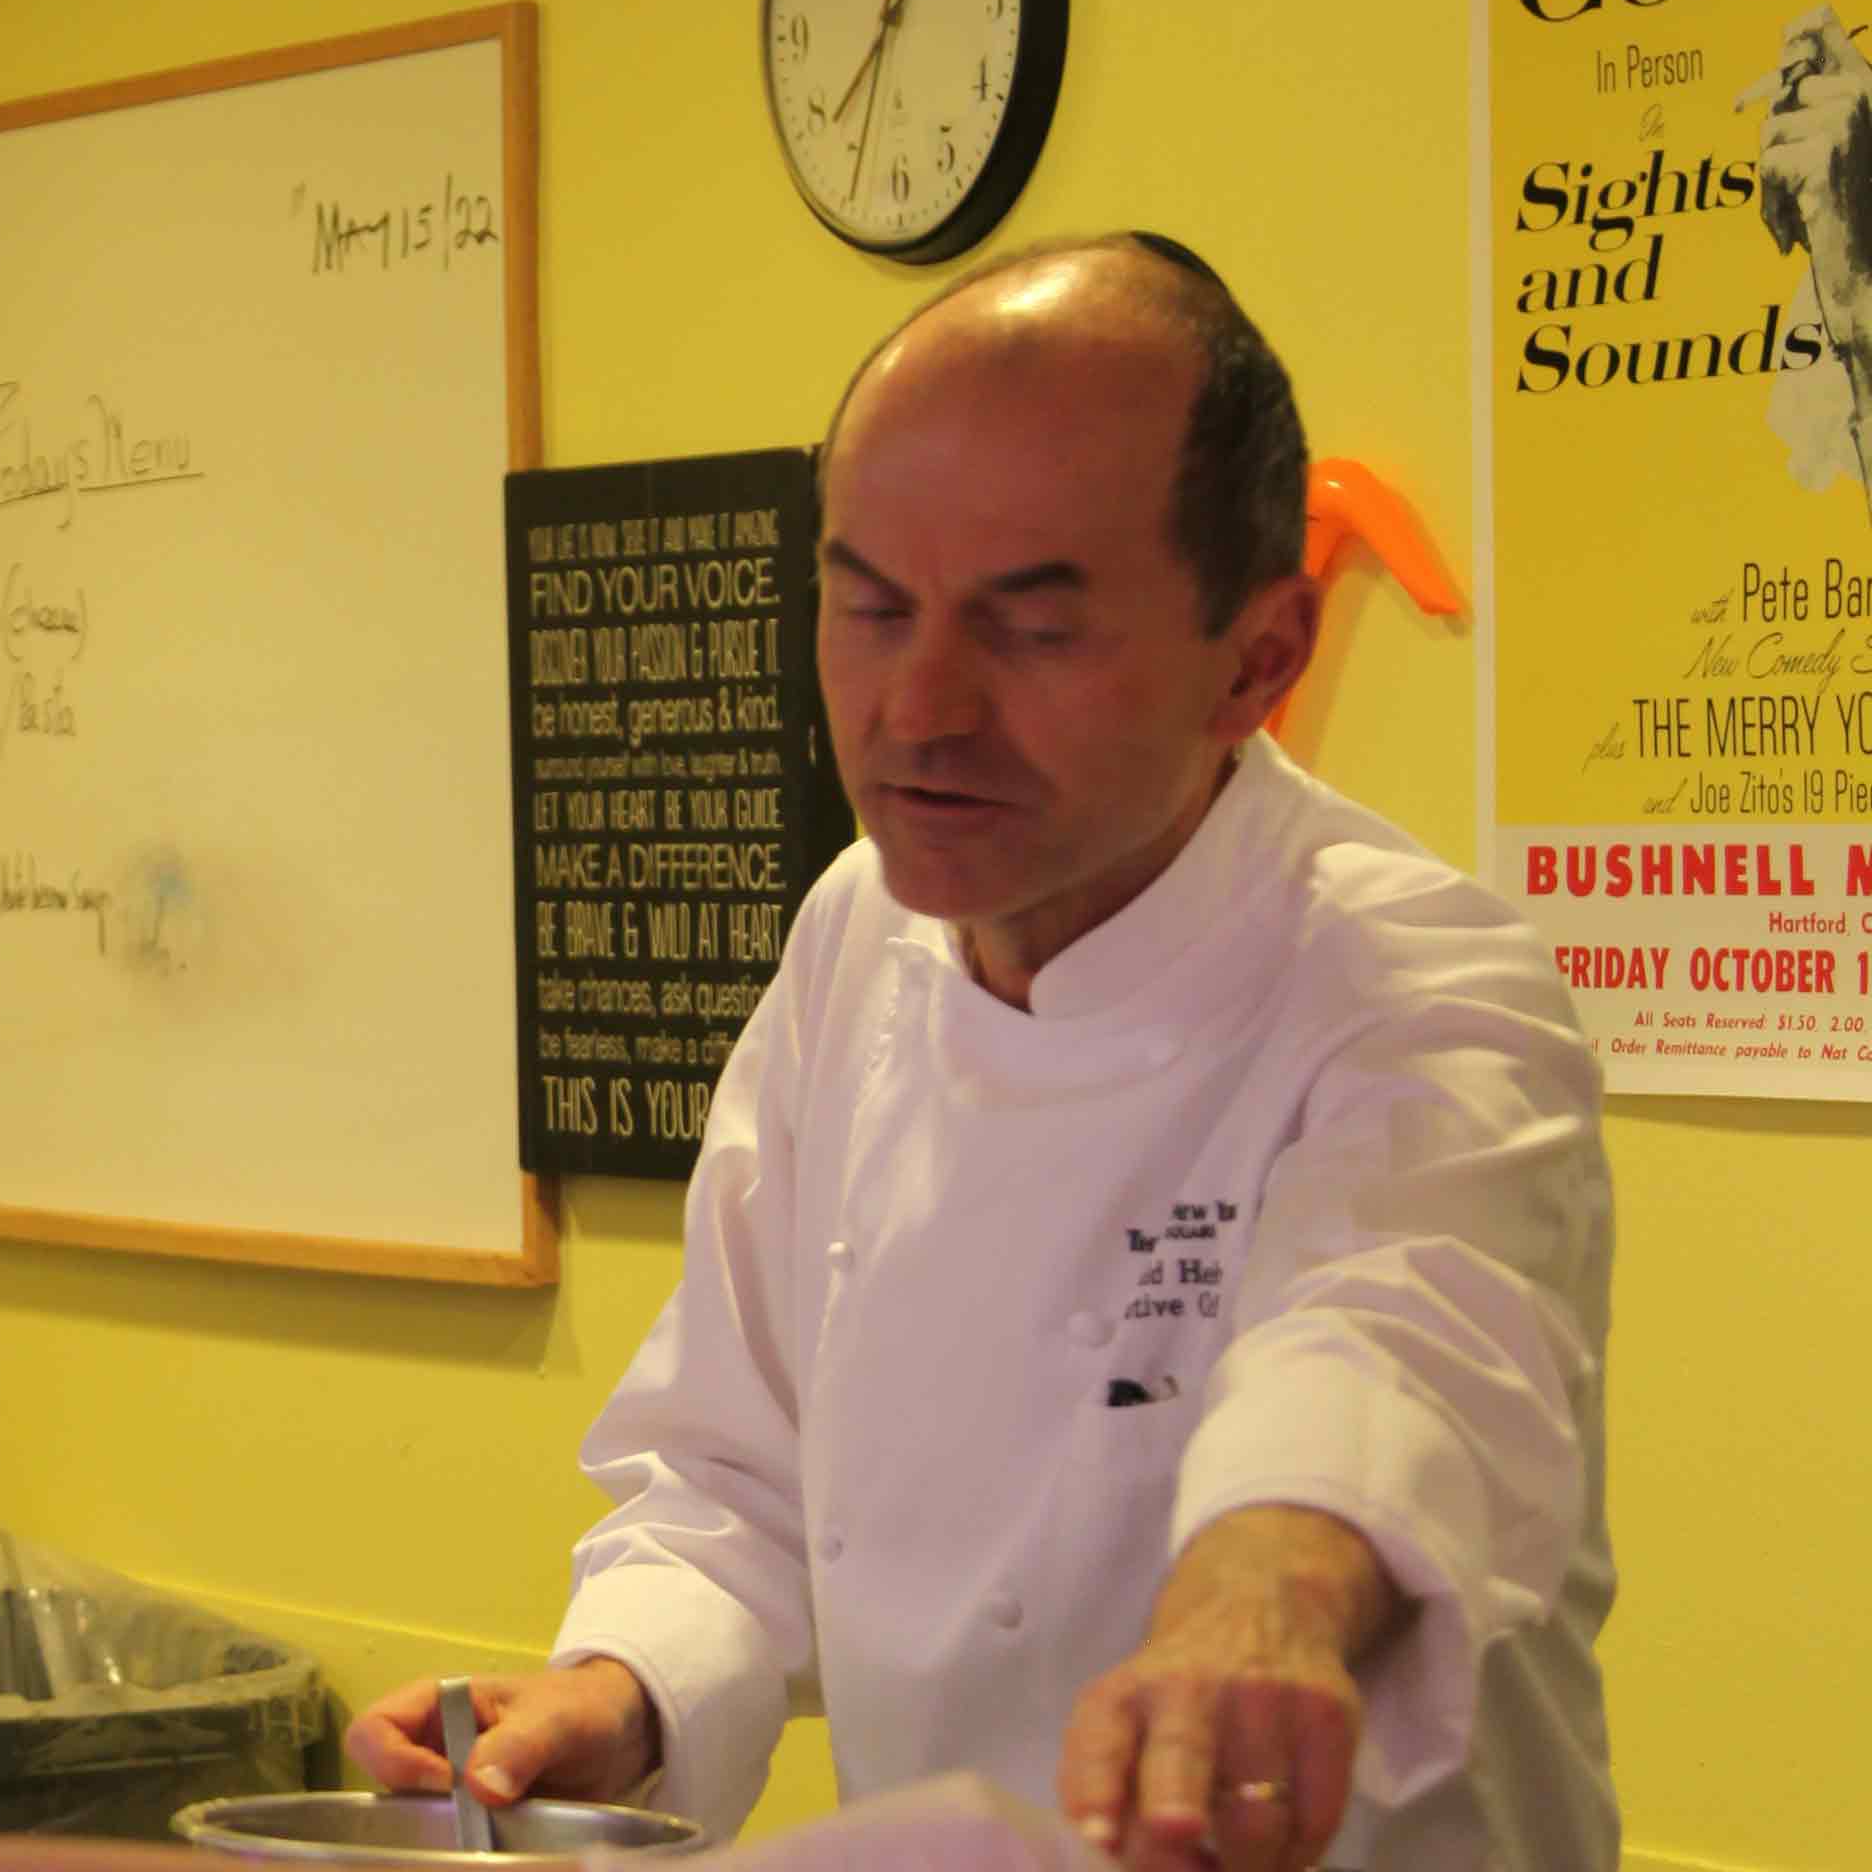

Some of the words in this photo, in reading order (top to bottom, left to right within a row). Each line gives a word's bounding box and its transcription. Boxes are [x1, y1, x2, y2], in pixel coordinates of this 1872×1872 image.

[791, 14, 810, 64] 9
[971, 56, 990, 102] 4
[1596, 50, 1616, 94] In
[1627, 45, 1703, 89] Person
[936, 123, 956, 172] 5
[891, 152, 910, 204] 6
[1516, 149, 1757, 253] Sights
[1517, 233, 1664, 314] and
[1516, 304, 1823, 394] Sounds
[530, 569, 592, 617] FIND
[597, 564, 679, 616] YOUR
[684, 557, 781, 610] VOICE.
[1743, 562, 1809, 623] Pete
[1681, 632, 1741, 680] New
[1745, 628, 1846, 696] Comedy
[532, 693, 556, 737] be
[559, 692, 624, 740] honest,
[629, 697, 714, 747] generous
[735, 684, 783, 732] kind.
[1632, 698, 1692, 758] THE
[1706, 694, 1820, 758] MERRY
[535, 791, 561, 831] LET
[566, 790, 604, 831] YOUR
[608, 789, 657, 830] HEART
[664, 789, 683, 830] BE
[688, 788, 728, 830] YOUR
[1689, 771, 1730, 815] Joe
[1739, 768, 1794, 815] Zito's
[1803, 768, 1824, 815] 19
[535, 842, 602, 889] MAKE
[607, 843, 625, 889] A
[629, 842, 786, 891] DIFFERENCE.
[1527, 843, 1815, 897] BUSHNELL
[536, 901, 558, 959] BE
[564, 900, 616, 960] BRAVE
[647, 901, 692, 961] WILD
[698, 902, 721, 960] AT
[1768, 911, 1850, 936] Hartford,
[537, 968, 577, 1011] take
[580, 969, 656, 1018] chances,
[661, 972, 694, 1016] ask
[1689, 947, 1836, 994] OCTOBER
[1634, 1012, 1654, 1027] All
[1663, 1013, 1697, 1029] Seats
[1610, 1037, 1648, 1056] Order
[1655, 1039, 1727, 1058] Remittance
[1734, 1043, 1788, 1060] payable
[1798, 1044, 1812, 1059] to
[1821, 1042, 1848, 1061] Nat
[542, 1075, 598, 1134] THIS
[611, 1076, 634, 1137] IS
[645, 1079, 710, 1141] YOUR
